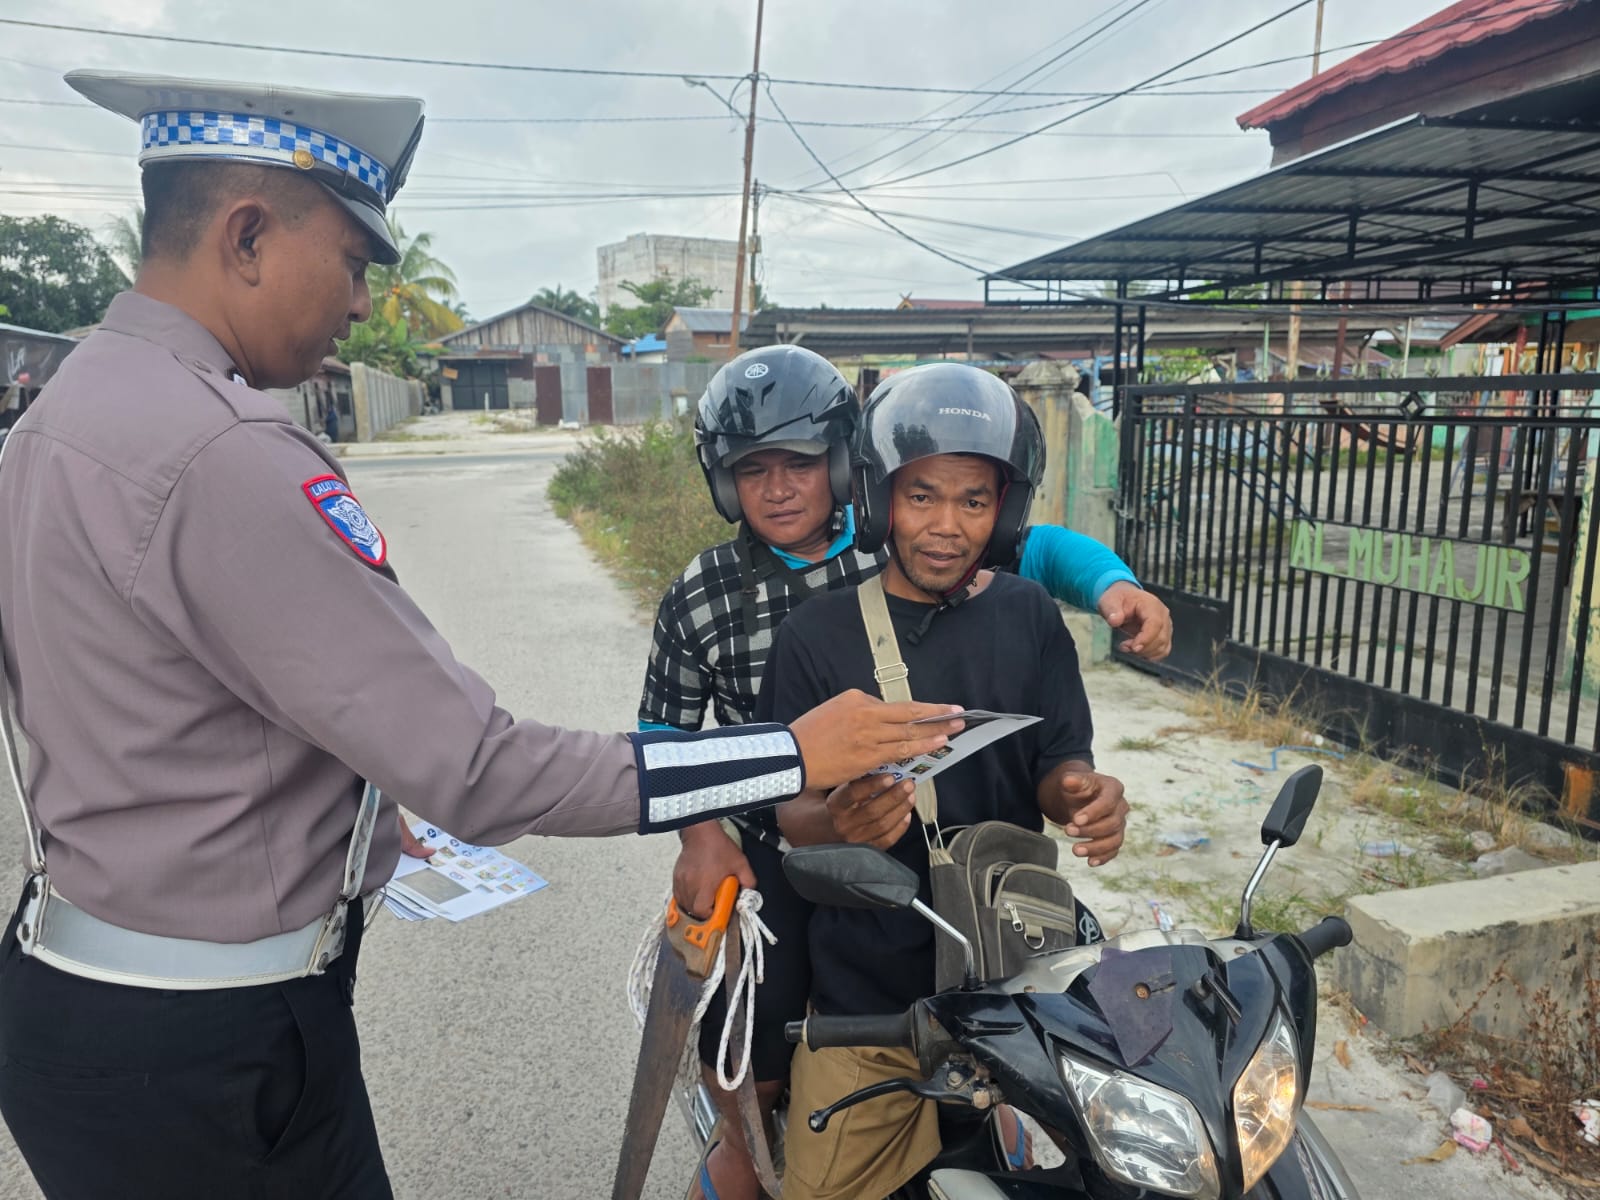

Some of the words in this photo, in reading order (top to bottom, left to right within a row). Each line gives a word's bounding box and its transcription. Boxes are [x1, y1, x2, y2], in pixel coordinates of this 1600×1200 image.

[938, 407, 992, 422] HONDA
[311, 480, 333, 497] LALU
[1291, 519, 1336, 574] AL
[1347, 526, 1532, 612] MUHAJIR
